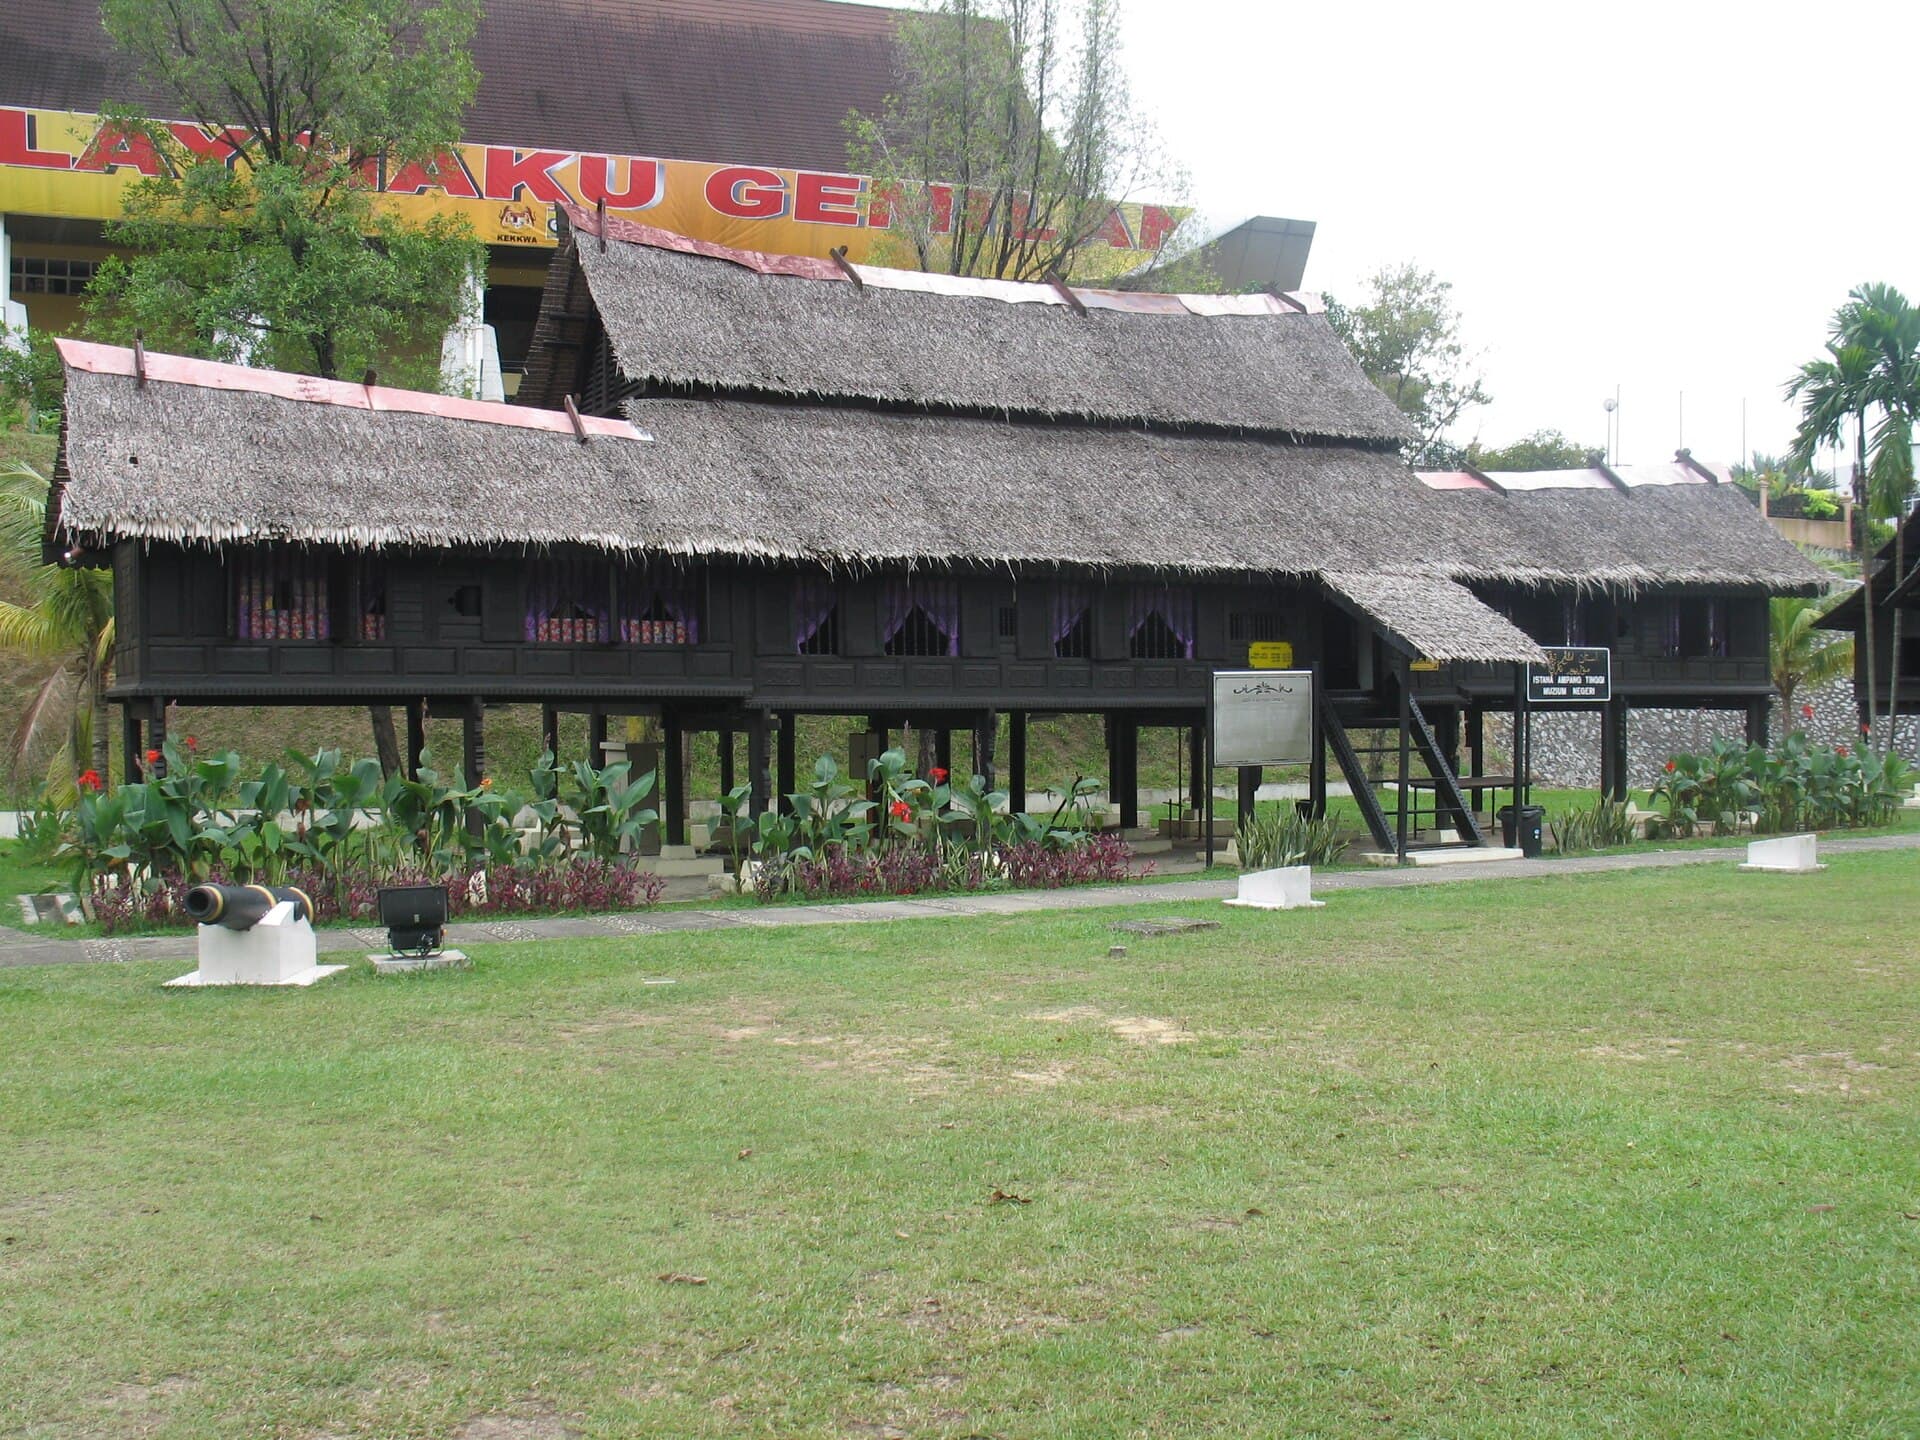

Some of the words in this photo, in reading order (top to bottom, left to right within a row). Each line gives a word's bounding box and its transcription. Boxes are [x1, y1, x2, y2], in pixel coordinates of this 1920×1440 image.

[497, 234, 537, 244] KEKKWA
[1533, 675, 1553, 684] ISTANA
[1558, 675, 1582, 684] AMPANG
[1543, 687, 1567, 695] MUZIUM
[1572, 687, 1595, 695] NEGERI
